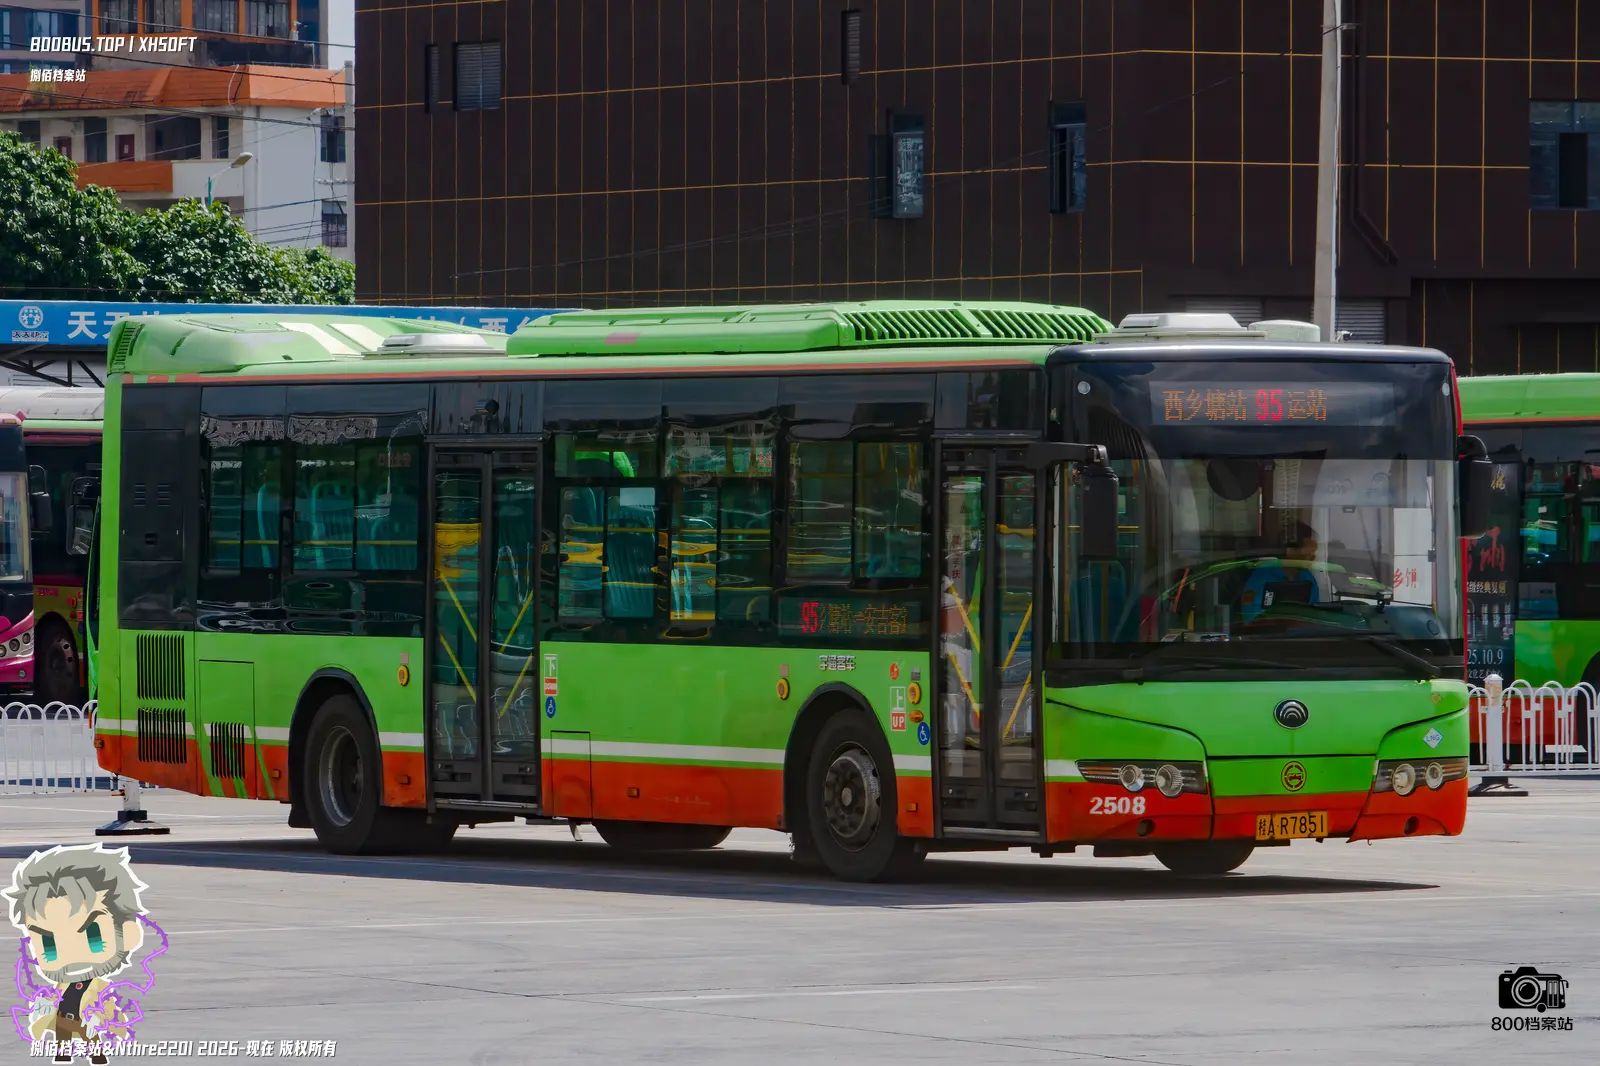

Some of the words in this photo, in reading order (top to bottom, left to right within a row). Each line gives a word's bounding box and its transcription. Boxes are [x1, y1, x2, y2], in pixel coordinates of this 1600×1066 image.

[1163, 389, 1247, 421] 西乡塘站
[1256, 389, 1283, 421] 95
[1287, 389, 1328, 421] 运站
[801, 602, 819, 633] 95
[892, 715, 905, 728] UP
[1425, 734, 1441, 743] LNG
[1089, 796, 1146, 815] 2508
